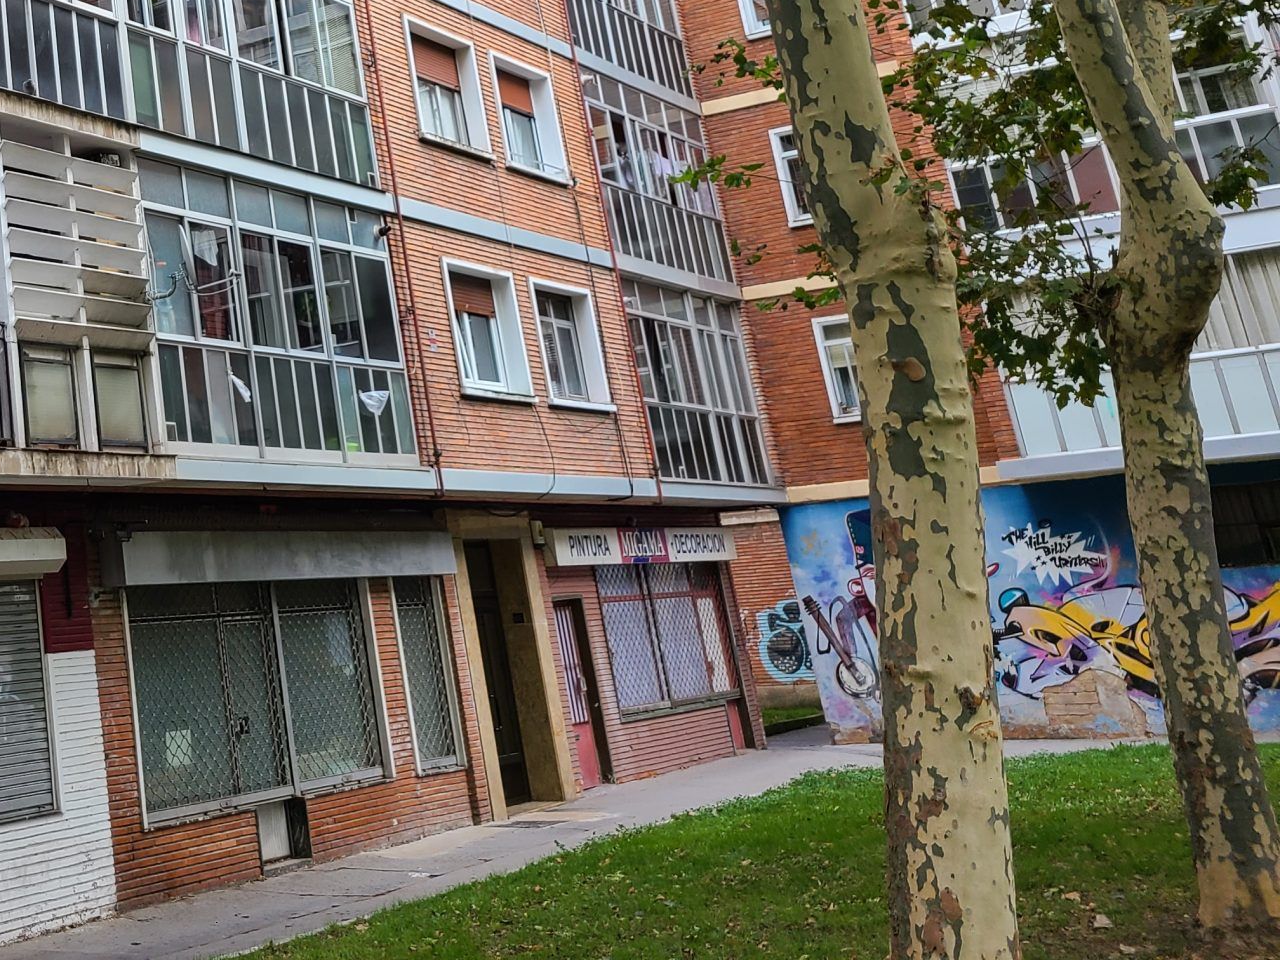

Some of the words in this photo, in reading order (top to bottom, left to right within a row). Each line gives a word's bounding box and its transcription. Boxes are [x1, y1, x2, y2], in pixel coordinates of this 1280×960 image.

[568, 534, 611, 557] PINTURA
[620, 530, 666, 557] MIGAMA
[673, 534, 726, 554] DECORACION
[1001, 528, 1029, 546] THE
